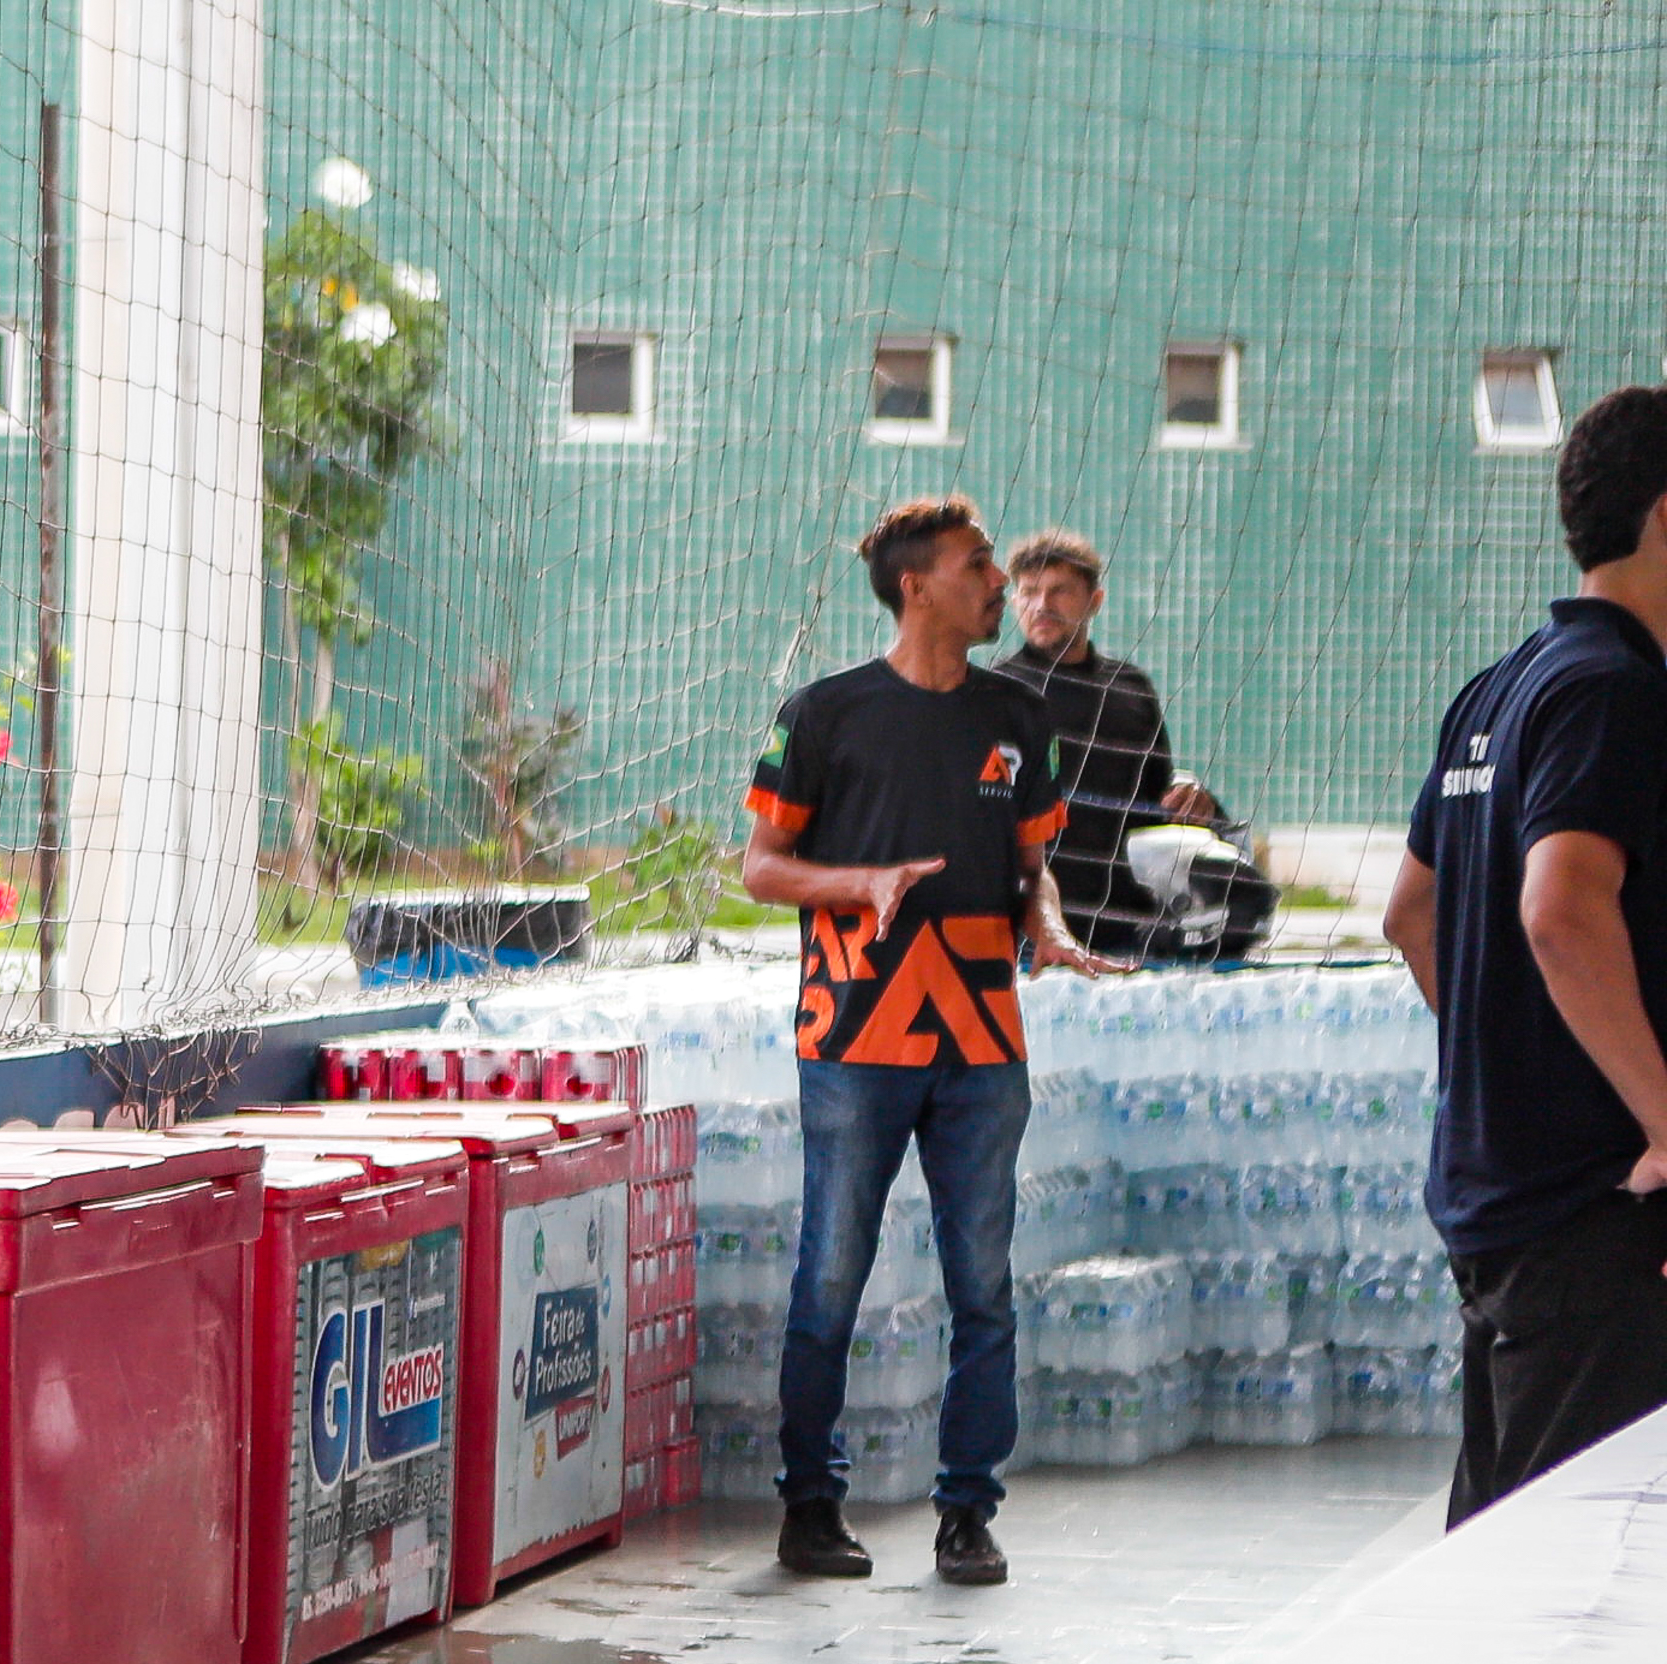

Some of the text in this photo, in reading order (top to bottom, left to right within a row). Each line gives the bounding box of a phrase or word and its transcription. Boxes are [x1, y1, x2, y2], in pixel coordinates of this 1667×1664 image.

[542, 1298, 575, 1350] Feira
[309, 1298, 443, 1491] GIL
[382, 1347, 443, 1414] EVENTOS
